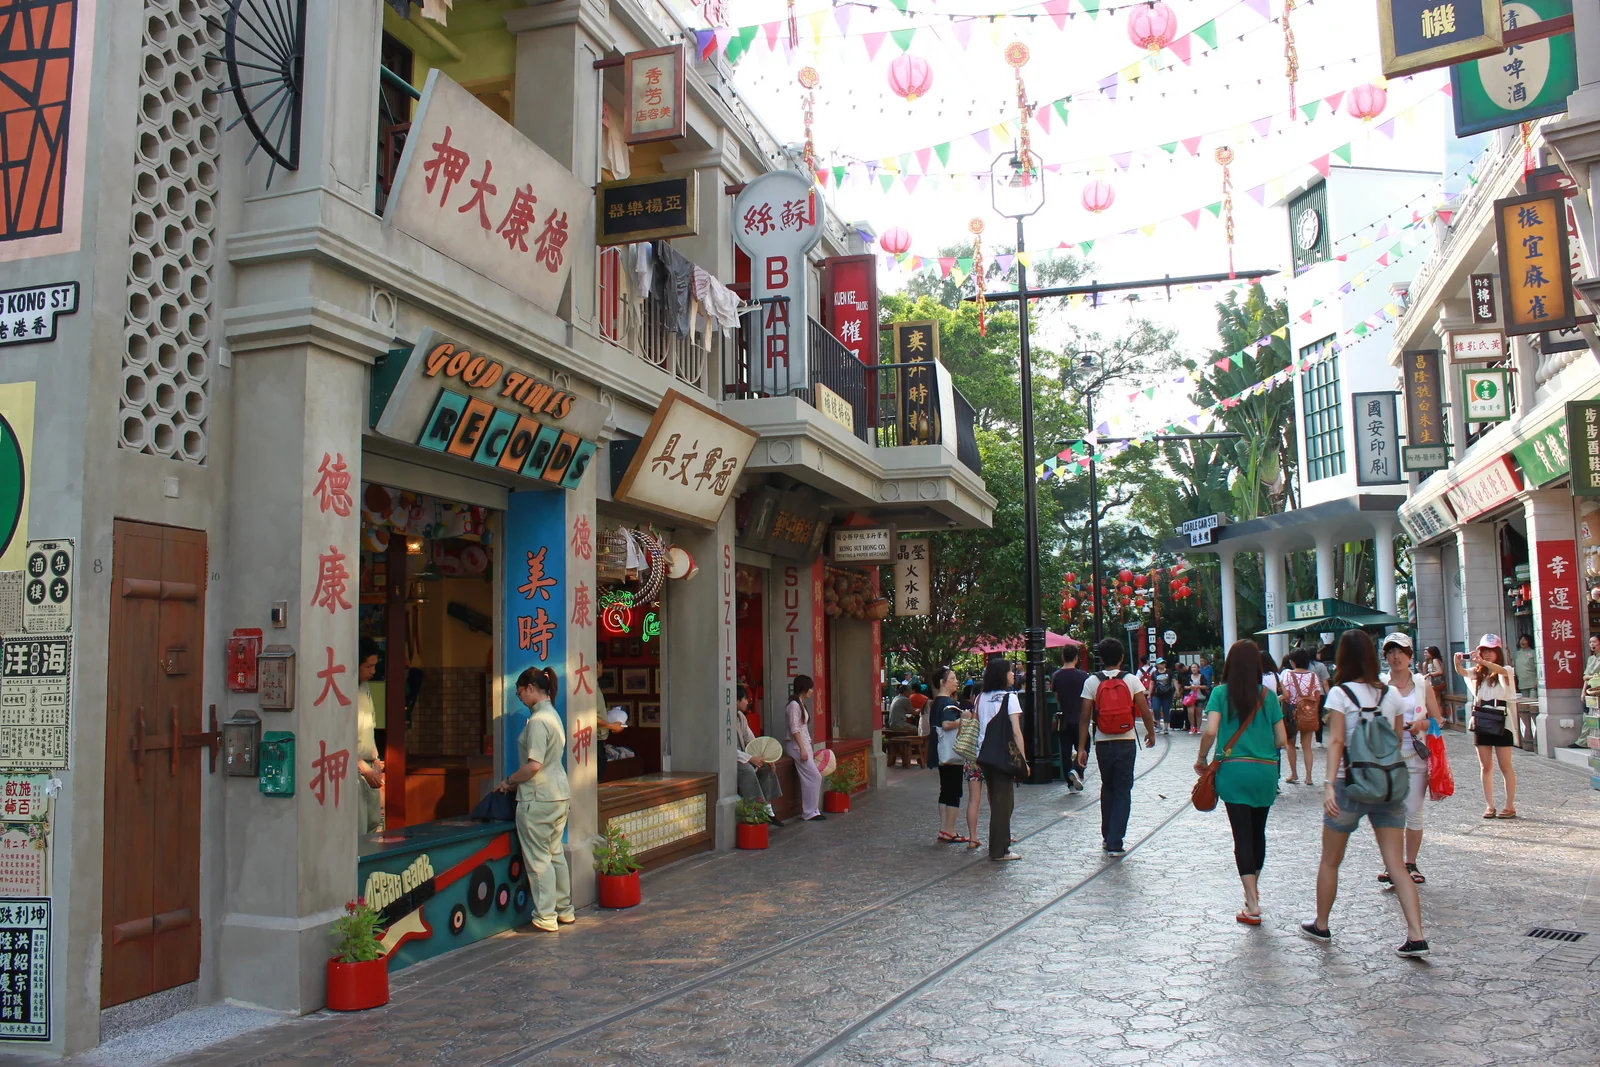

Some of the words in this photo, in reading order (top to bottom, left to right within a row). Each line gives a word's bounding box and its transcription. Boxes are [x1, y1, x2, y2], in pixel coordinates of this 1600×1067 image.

[847, 290, 856, 305] KEE
[1517, 204, 1550, 320] 振宜麻雀
[8, 291, 46, 313] KONG
[855, 300, 869, 311] TAILORS
[425, 342, 504, 389] GOOD
[430, 406, 590, 480] RECORDS
[1366, 399, 1389, 477] 國安印刷
[1184, 520, 1198, 533] CABLE
[1197, 518, 1208, 529] CAR
[93, 558, 103, 574] 8
[516, 546, 558, 661] 美時
[310, 451, 353, 808] 德康大押
[570, 514, 593, 767] 德康大押
[785, 566, 799, 678] SUZIE
[1547, 555, 1577, 674] 幸運雜貨
